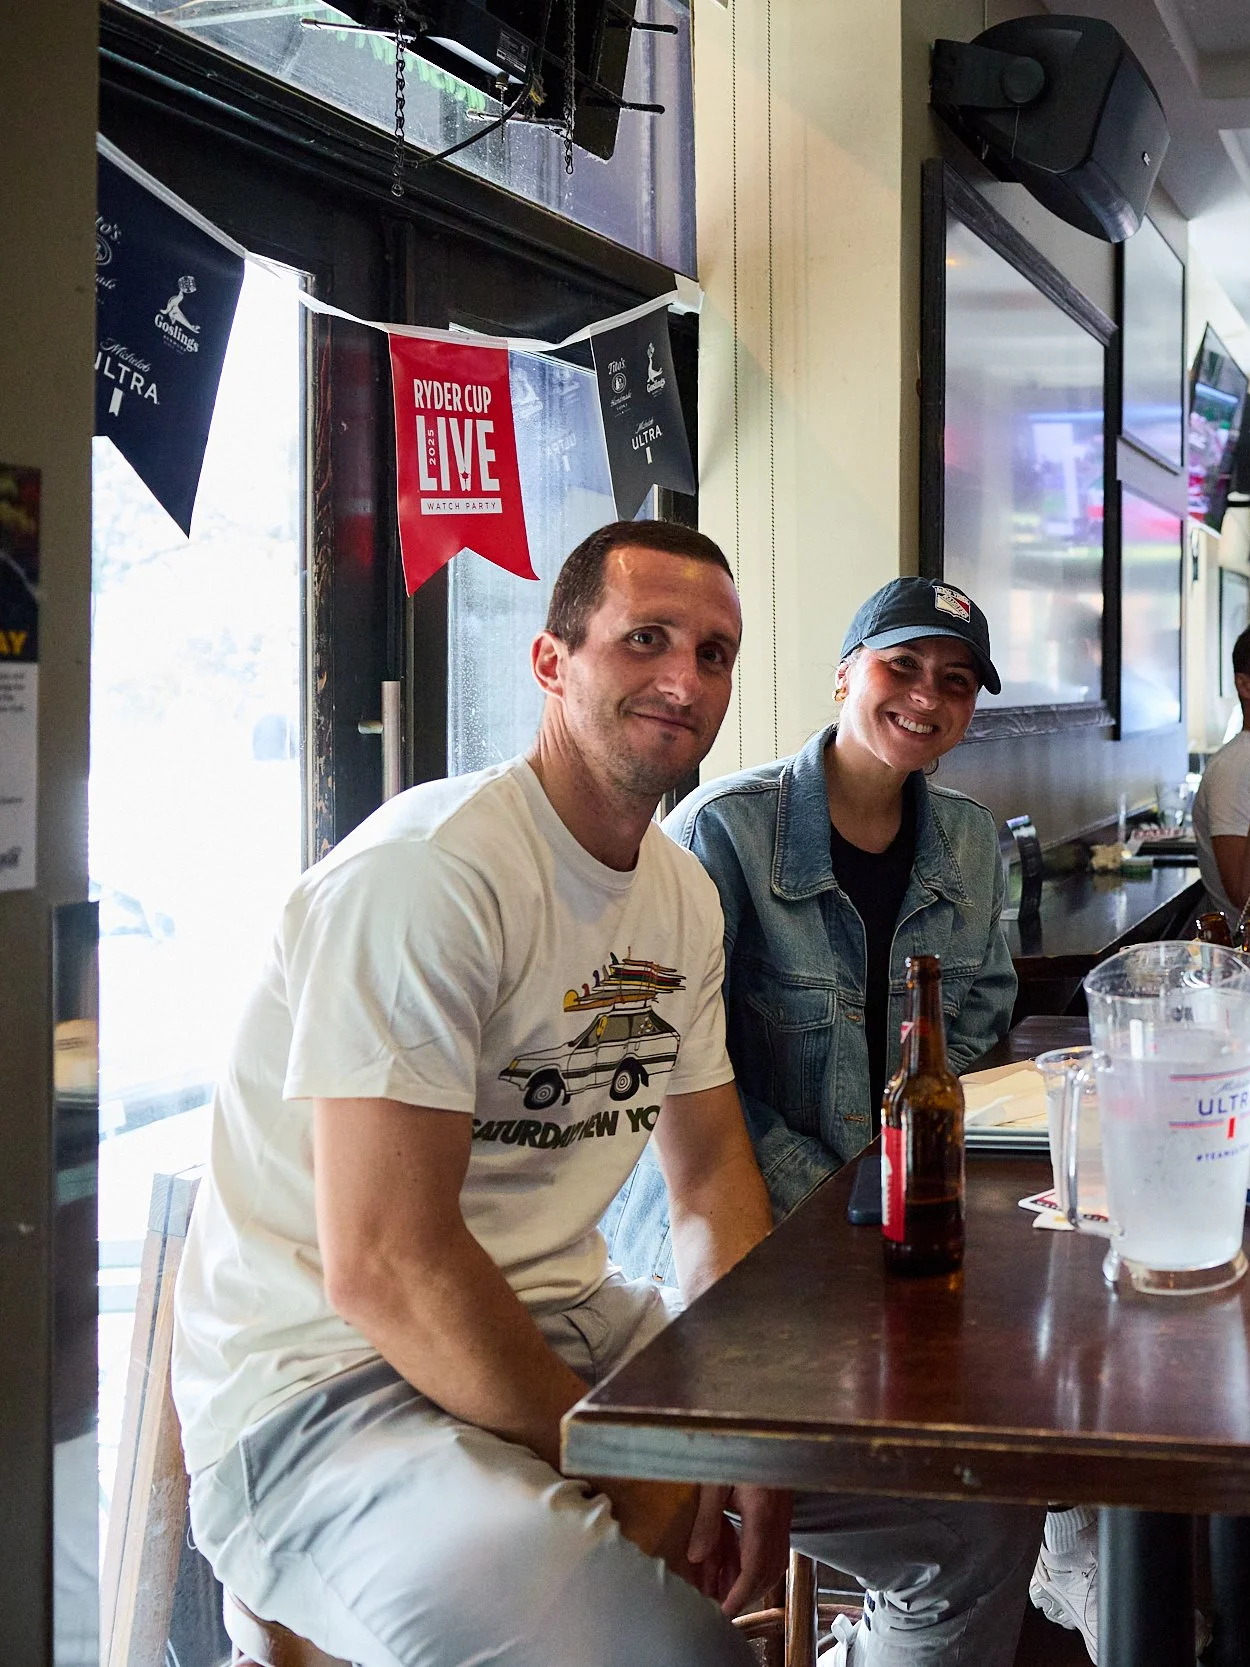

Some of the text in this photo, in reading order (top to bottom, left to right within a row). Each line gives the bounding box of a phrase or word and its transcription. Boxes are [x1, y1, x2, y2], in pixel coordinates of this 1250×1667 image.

[154, 313, 199, 352] Goslings
[100, 337, 151, 372] Michelob
[413, 379, 492, 413] RYDER CUP
[416, 415, 500, 491] LIVE
[427, 429, 437, 465] 2025
[631, 425, 663, 450] ULTRA
[427, 502, 496, 510] WATCH PARTY
[626, 1105, 661, 1132] YO
